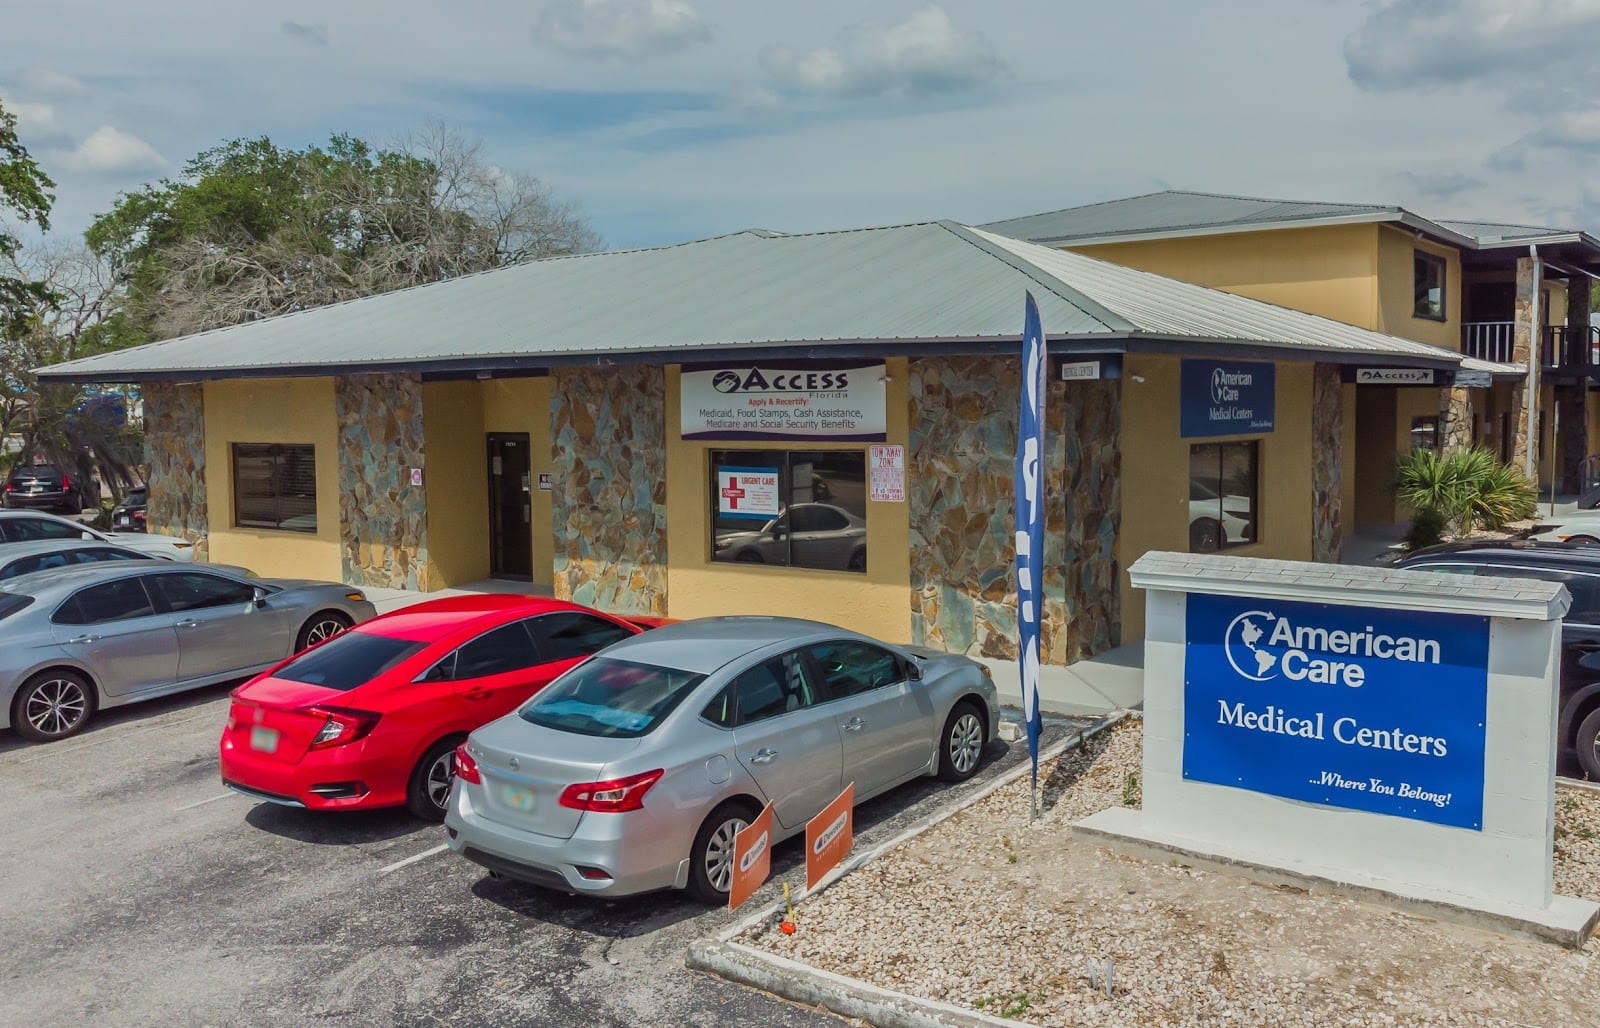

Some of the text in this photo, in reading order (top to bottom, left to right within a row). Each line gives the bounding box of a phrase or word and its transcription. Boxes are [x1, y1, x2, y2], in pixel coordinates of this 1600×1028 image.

[1220, 370, 1252, 386] American
[808, 391, 849, 399] Florida
[1222, 386, 1239, 401] Care
[748, 398, 767, 407] Apply
[768, 398, 775, 406] &
[699, 408, 864, 420] Medicaid, Food Stamps, Cash Assistance,
[1209, 406, 1253, 420] Medical Centers
[706, 419, 856, 431] Medicare and Social Security Benefits
[872, 447, 901, 458] TOW AWAY
[879, 457, 895, 468] ZONE
[741, 476, 775, 486] URGENT CARE
[1269, 616, 1441, 665] American
[1281, 649, 1366, 688] Care
[1216, 699, 1448, 757] Medical Centers
[1309, 770, 1452, 808] ...Where You Belong!
